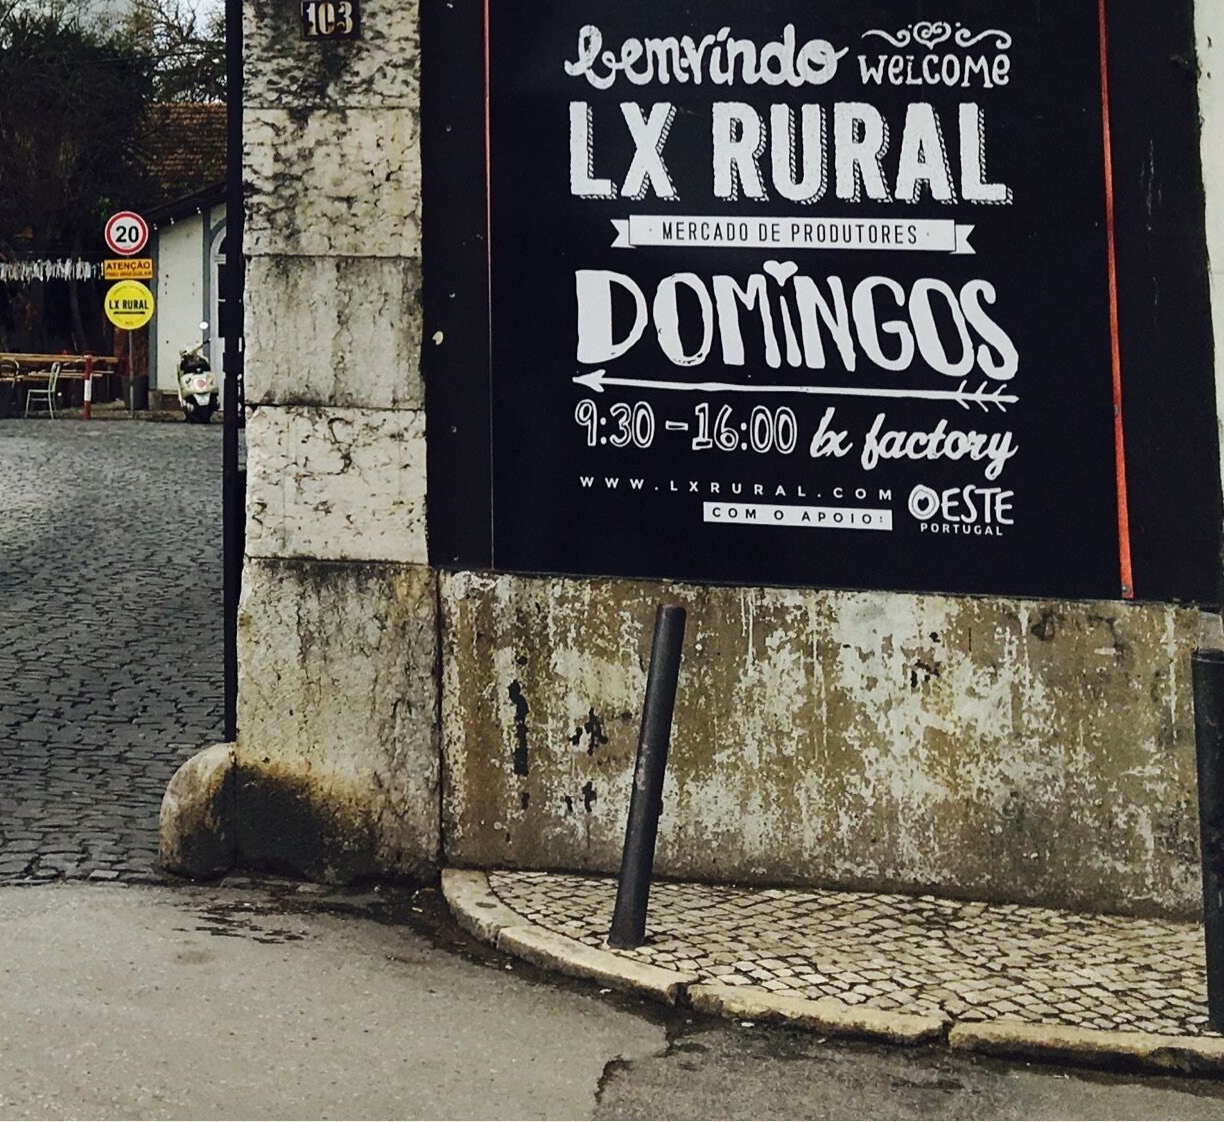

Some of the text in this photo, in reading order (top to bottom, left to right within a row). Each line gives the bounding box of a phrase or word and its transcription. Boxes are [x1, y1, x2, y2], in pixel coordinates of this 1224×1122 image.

[306, 0, 354, 36] 103
[569, 100, 1014, 205] LX RURAL
[115, 226, 140, 243] 20
[662, 221, 919, 245] MERCADO DE PRODUTORES
[106, 261, 151, 271] ATENÇÃO
[109, 299, 150, 310] LX RURAL
[575, 399, 655, 449] 9:30
[860, 413, 1019, 480] factory
[579, 476, 894, 502] WWW.LXRURAL.COM
[711, 507, 757, 520] COM
[773, 510, 785, 521] O
[907, 484, 1015, 526] OESTE
[920, 522, 1004, 536] PORTUGAL
